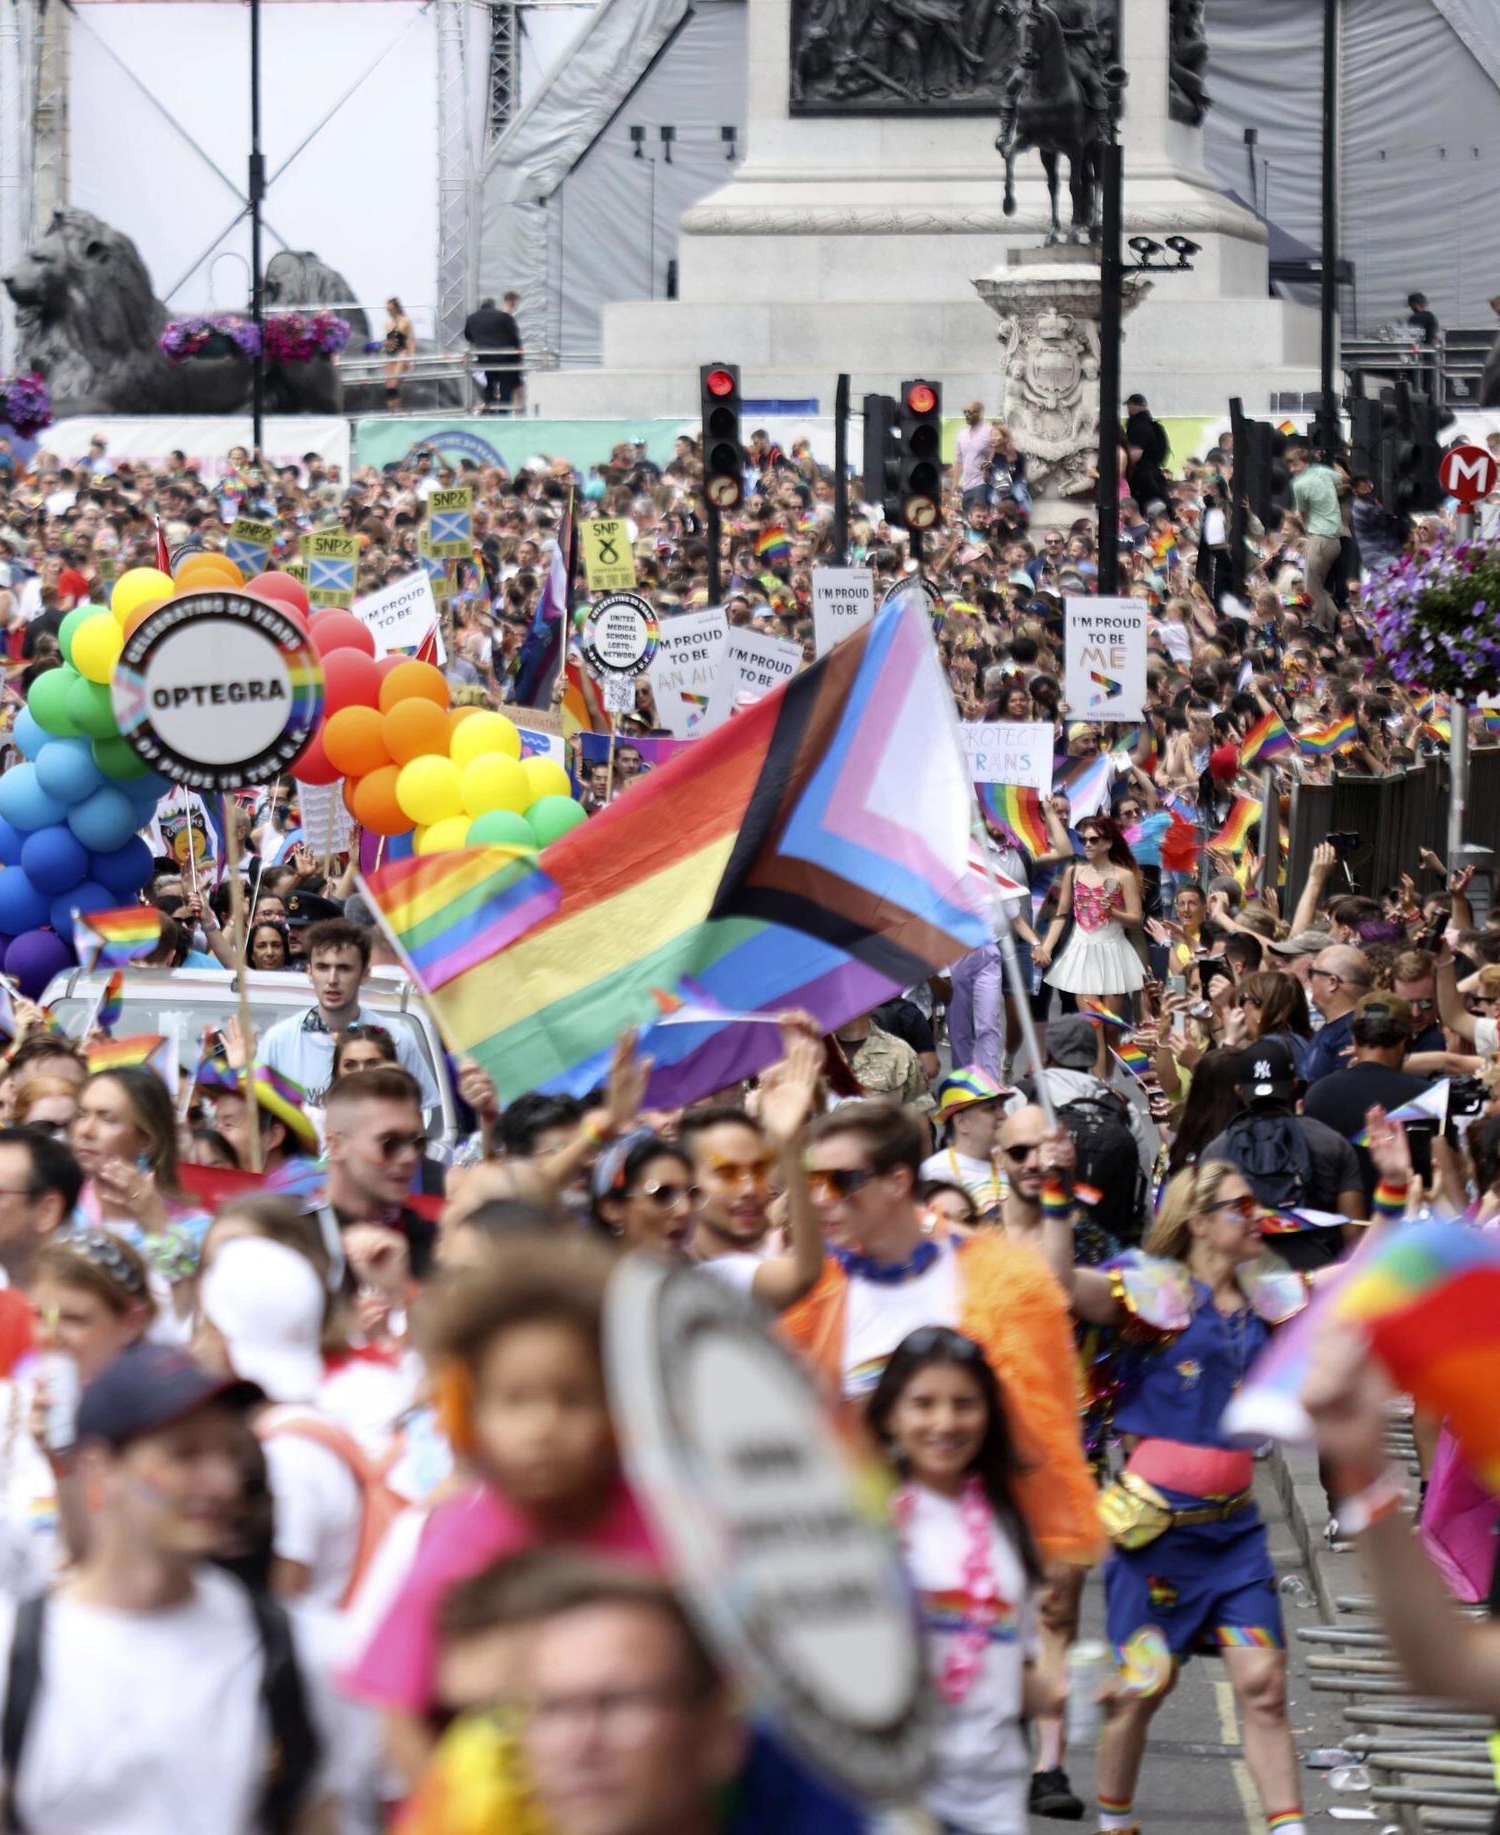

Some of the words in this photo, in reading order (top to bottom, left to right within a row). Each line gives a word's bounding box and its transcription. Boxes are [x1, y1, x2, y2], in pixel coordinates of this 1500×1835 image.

[1448, 453, 1490, 493] M
[434, 493, 457, 507] SNP
[236, 520, 261, 540] SNP
[592, 522, 619, 537] SNP
[315, 537, 342, 553] SNP
[381, 587, 426, 617] PROUD
[818, 588, 833, 599] I'M
[835, 588, 869, 599] PROUD
[378, 616, 396, 629] TO
[397, 606, 413, 621] BE
[609, 614, 636, 623] UNITED
[831, 604, 844, 615] TO
[846, 604, 859, 615] BE
[607, 623, 637, 632] MEDICAL
[1072, 617, 1093, 628] I'M
[1095, 617, 1142, 629] PROUD
[606, 632, 637, 641] SCHOOLS
[674, 629, 723, 648] PROUD
[1088, 633, 1106, 645] TO
[1109, 633, 1125, 645] BE
[669, 652, 689, 666] TO
[692, 648, 710, 661] BE
[728, 647, 748, 661] I'M
[749, 653, 793, 676] PROUD
[1079, 646, 1127, 670] ME
[739, 667, 757, 682] TO
[757, 673, 774, 687] BE
[152, 679, 287, 711] OPTEGRA
[963, 752, 1032, 772] TRANS
